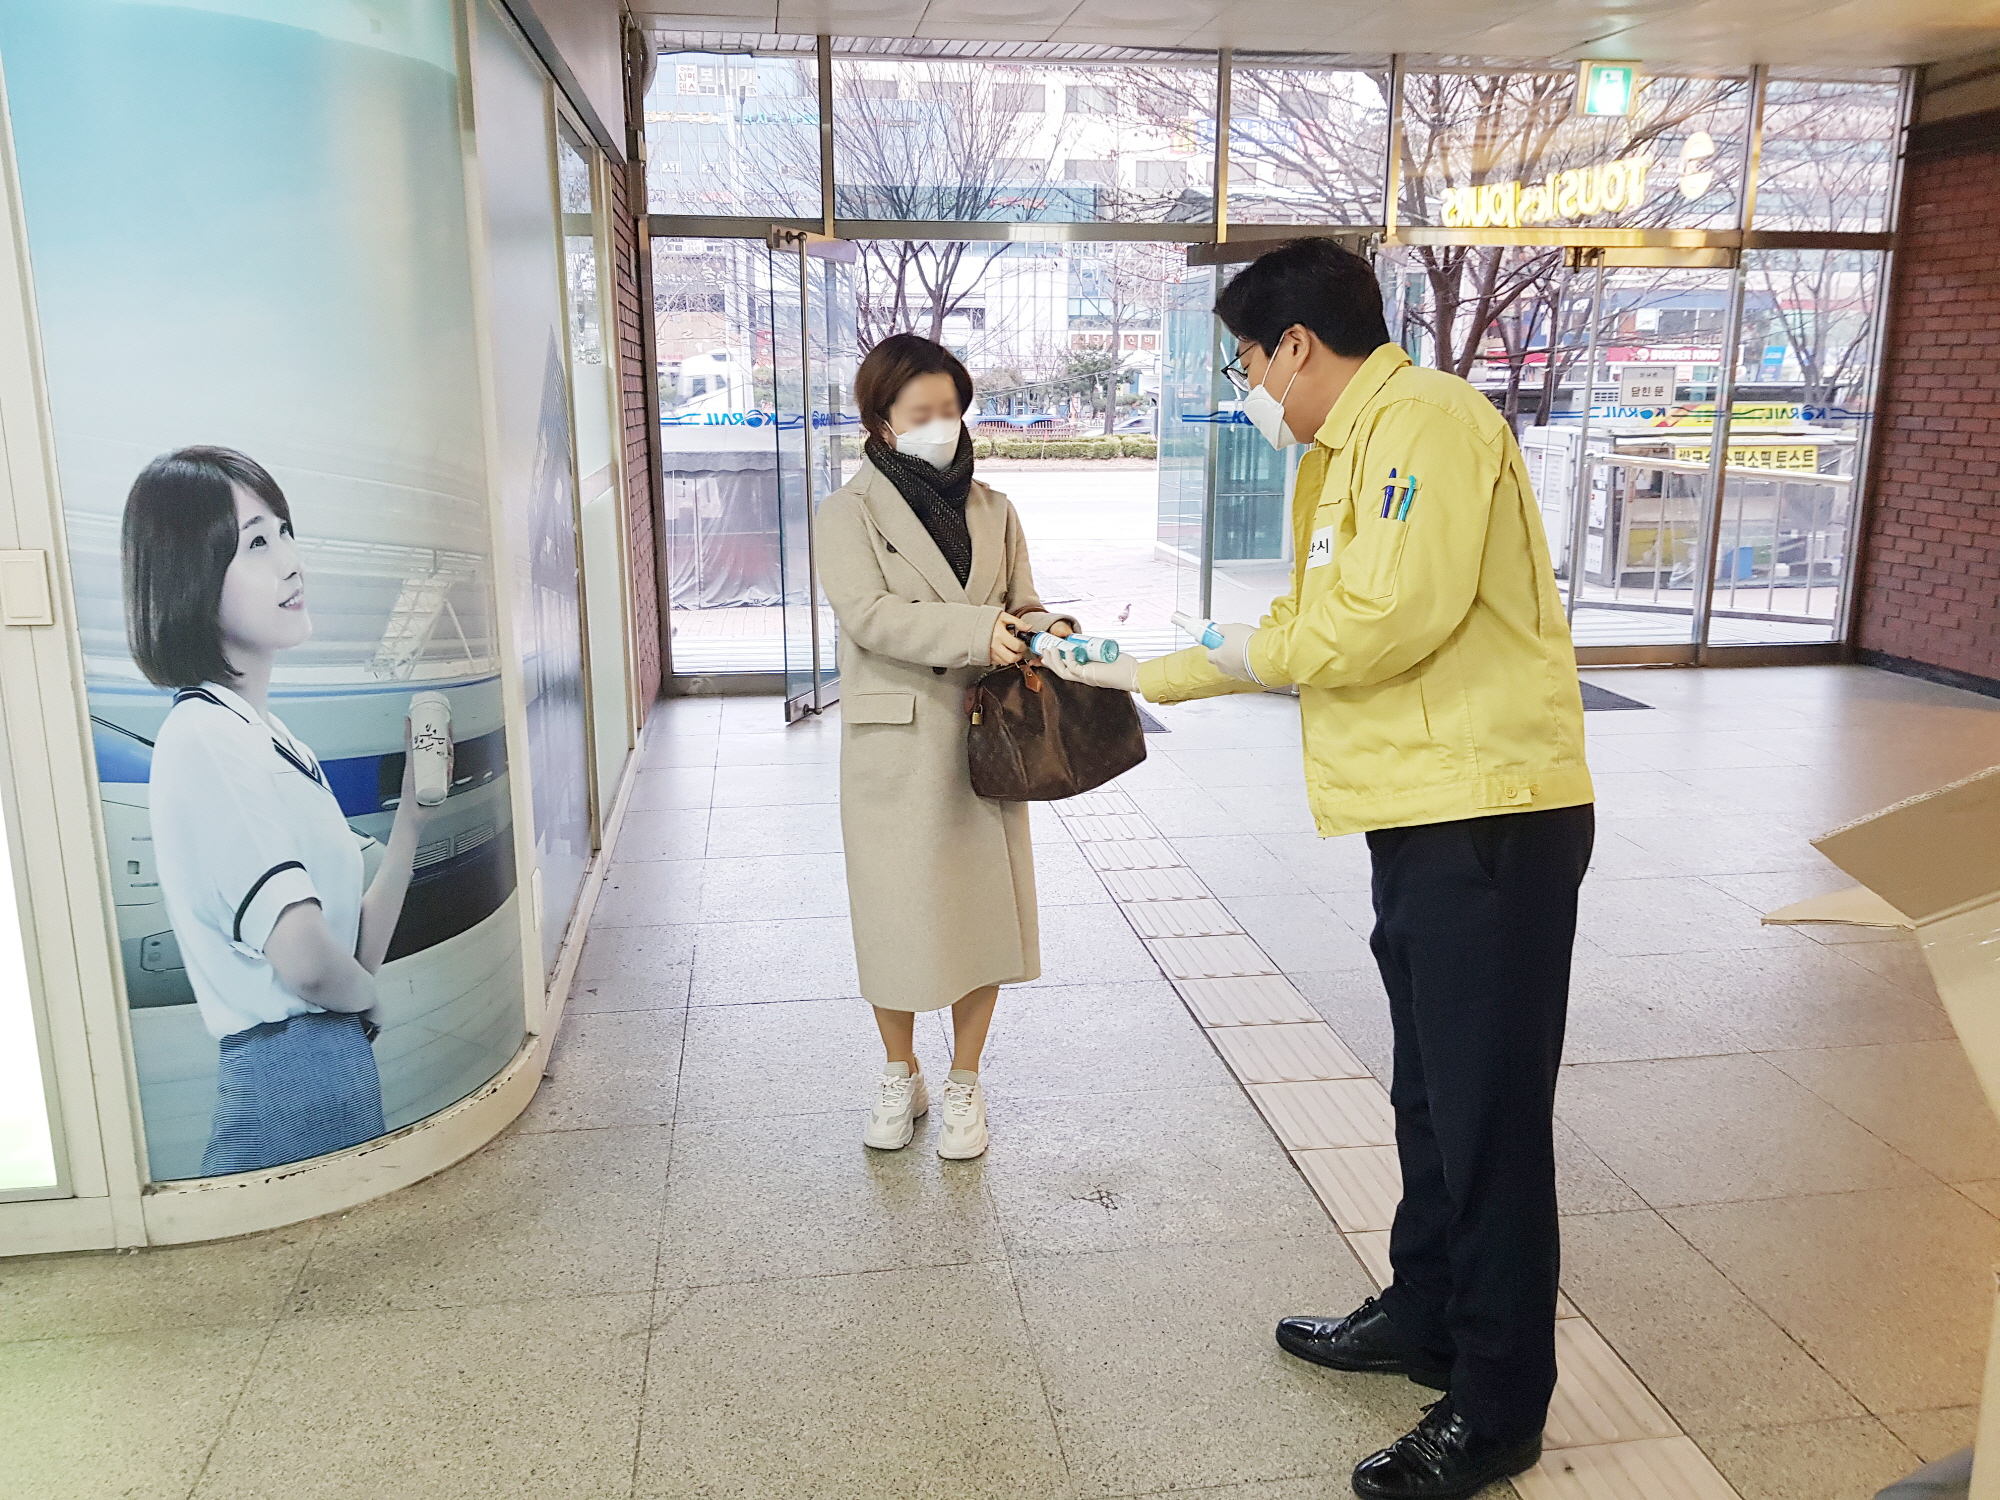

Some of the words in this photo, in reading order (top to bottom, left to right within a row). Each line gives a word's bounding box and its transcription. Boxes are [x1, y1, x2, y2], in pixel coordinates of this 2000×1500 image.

[1650, 350, 1692, 360] BURGER
[1692, 350, 1719, 360] KING
[1631, 386, 1650, 398] 닫힌
[1654, 386, 1664, 397] 문
